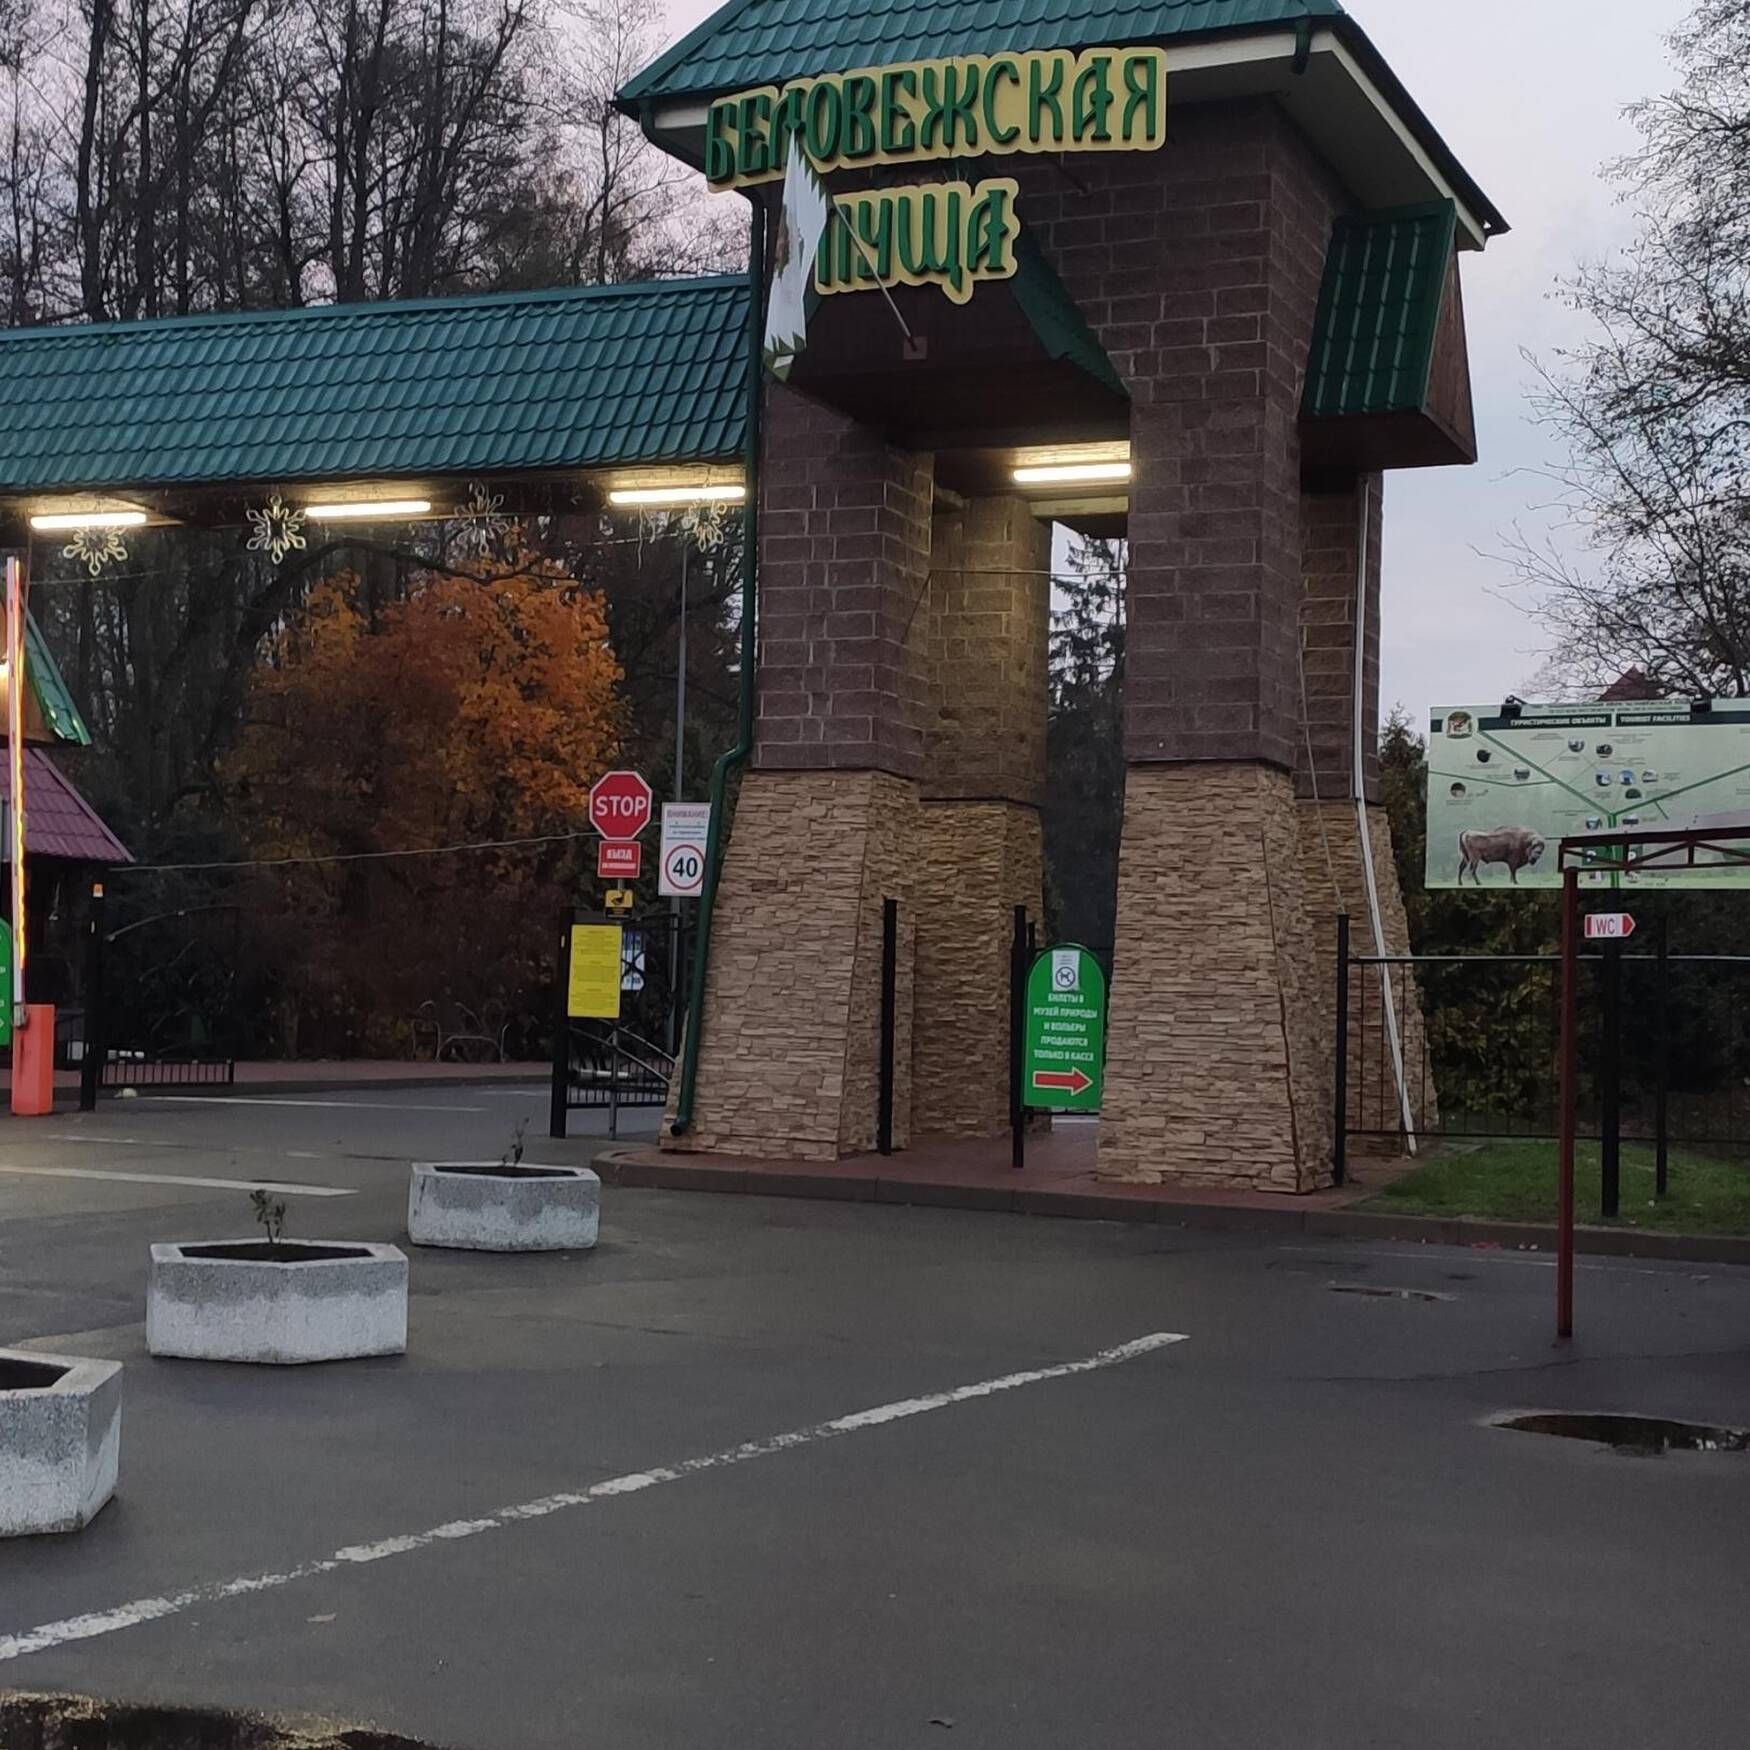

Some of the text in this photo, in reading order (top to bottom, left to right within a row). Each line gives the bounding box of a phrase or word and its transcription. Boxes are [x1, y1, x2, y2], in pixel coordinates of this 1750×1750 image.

[706, 55, 1159, 182] БЕЛОВЕЖСКАЯ
[817, 188, 1008, 293] ПУЩА
[595, 795, 647, 817] STOP
[672, 856, 698, 878] 40
[1595, 918, 1616, 935] WC
[1033, 1007, 1098, 1018] МУЗЕЙ ПРИРОДЫ
[1051, 1022, 1086, 1032] ВОЛЬЕРЫ
[1040, 1036, 1088, 1046] ПРОДАЮТСЯ
[1034, 1049, 1064, 1060] ТОЛЬКО
